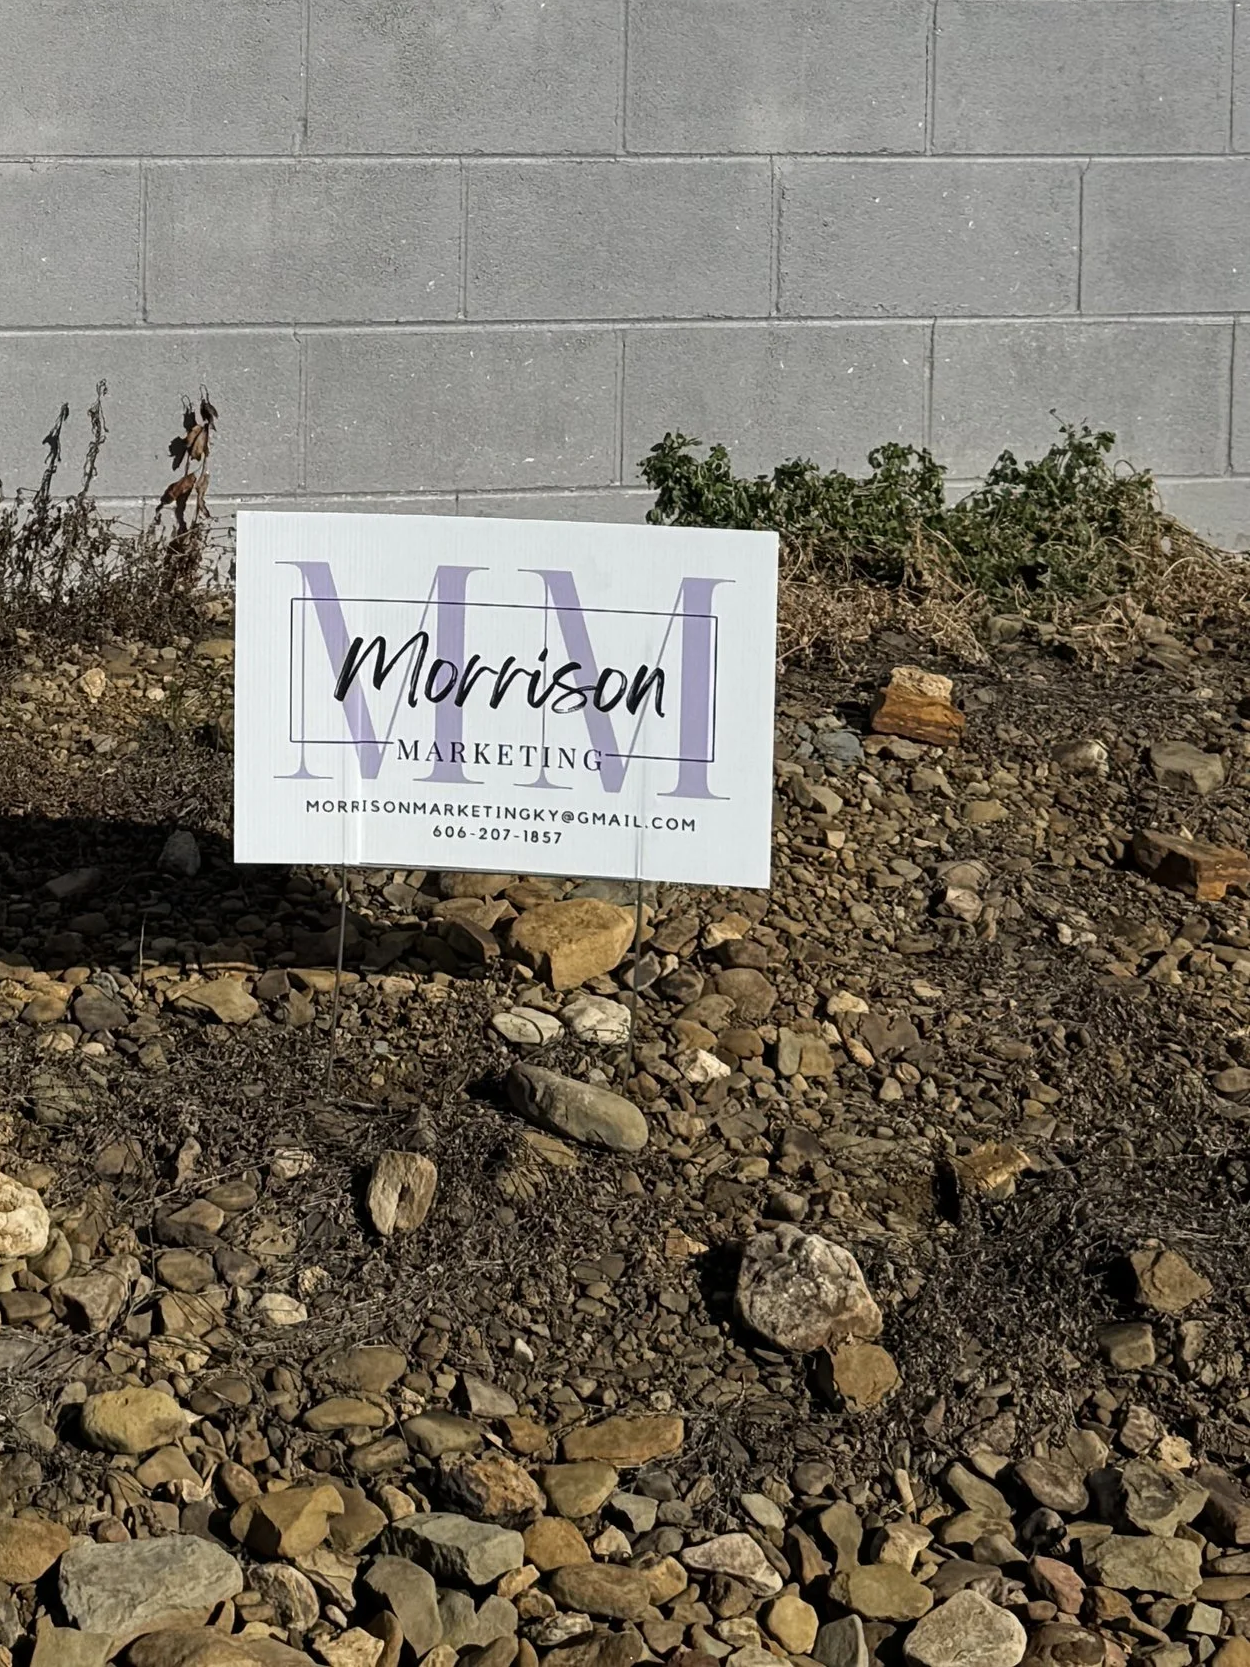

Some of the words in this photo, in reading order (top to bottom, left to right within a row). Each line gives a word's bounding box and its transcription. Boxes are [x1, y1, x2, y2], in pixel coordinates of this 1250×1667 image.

[333, 631, 666, 718] Morrison
[396, 738, 604, 773] MARKETING
[305, 799, 697, 833] MORRISONMARKETINGKY@GMAIL.COM
[432, 825, 563, 845] 606-207-1857
